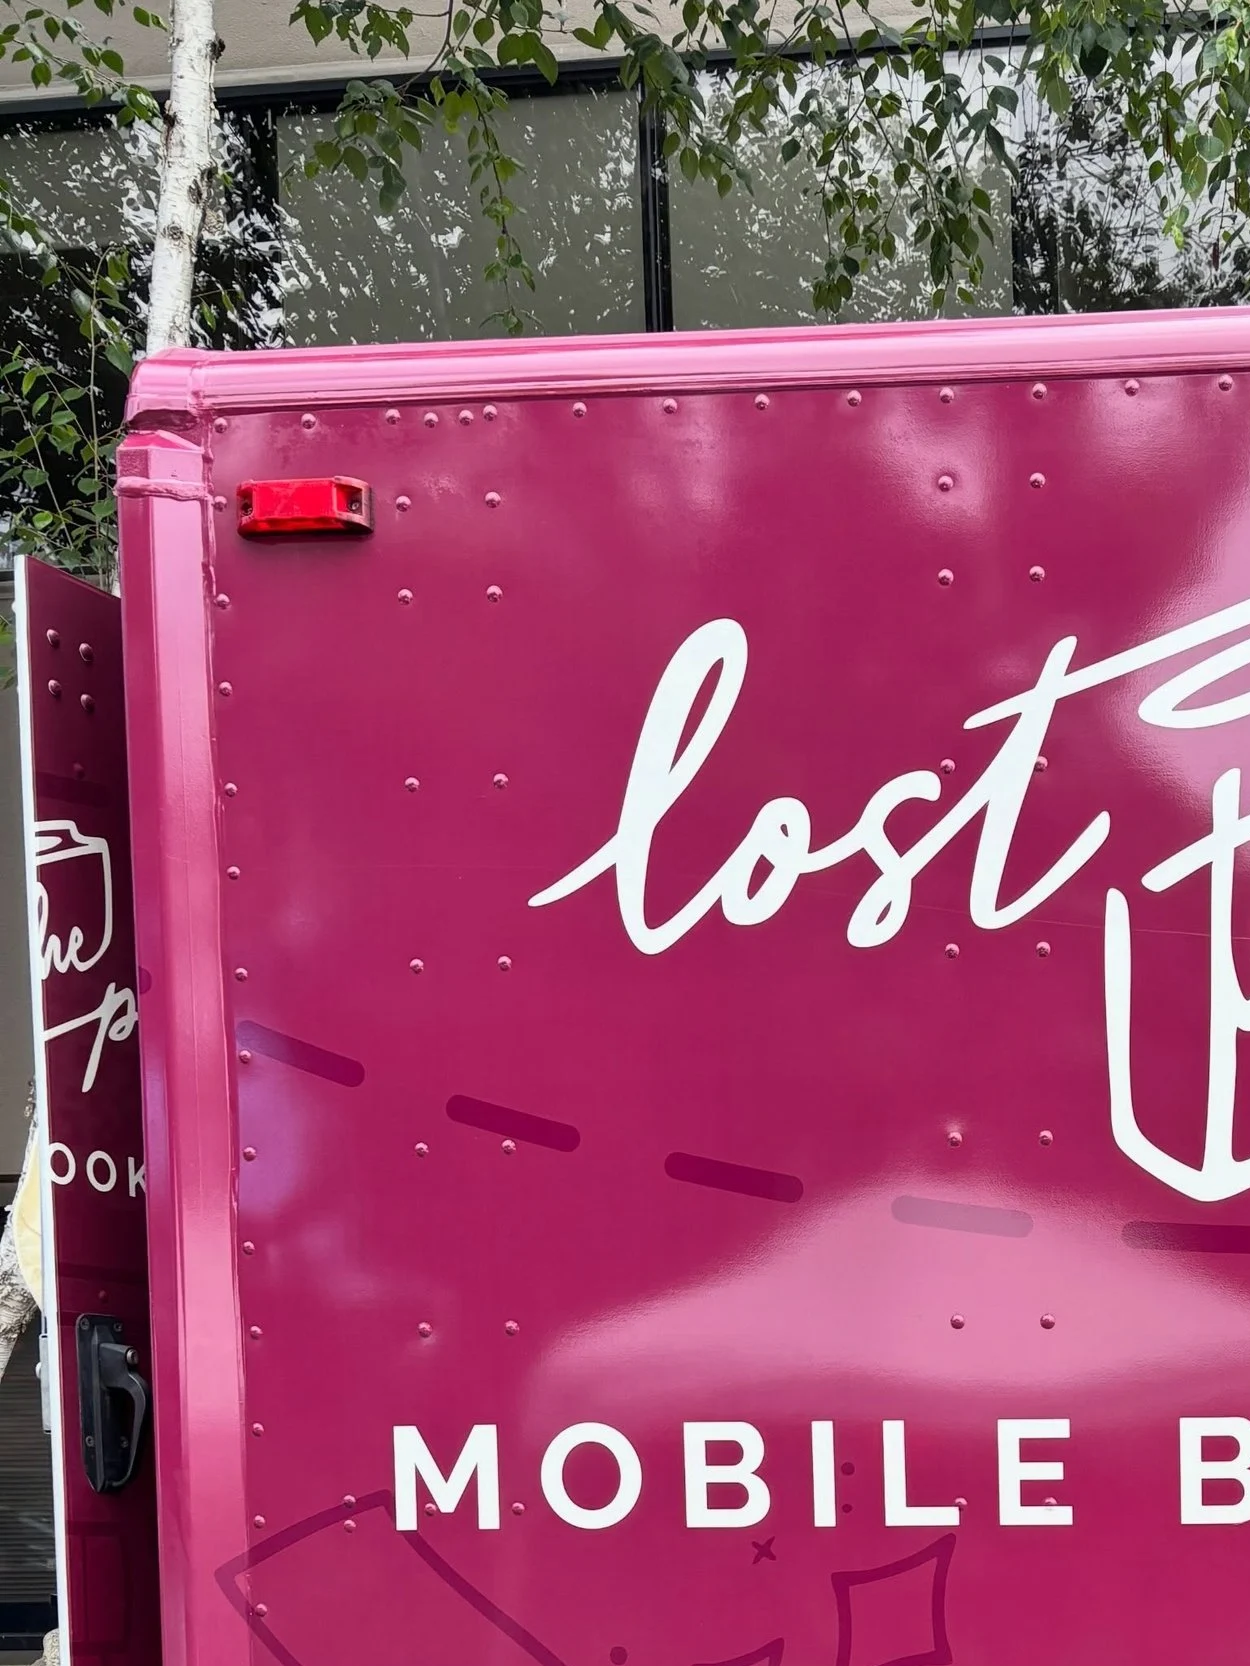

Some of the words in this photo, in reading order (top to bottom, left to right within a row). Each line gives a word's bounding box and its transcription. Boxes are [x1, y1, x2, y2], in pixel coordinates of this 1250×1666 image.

[529, 617, 1111, 953] lost
[48, 1142, 147, 1198] OOK
[394, 1421, 1074, 1531] MOBILE
